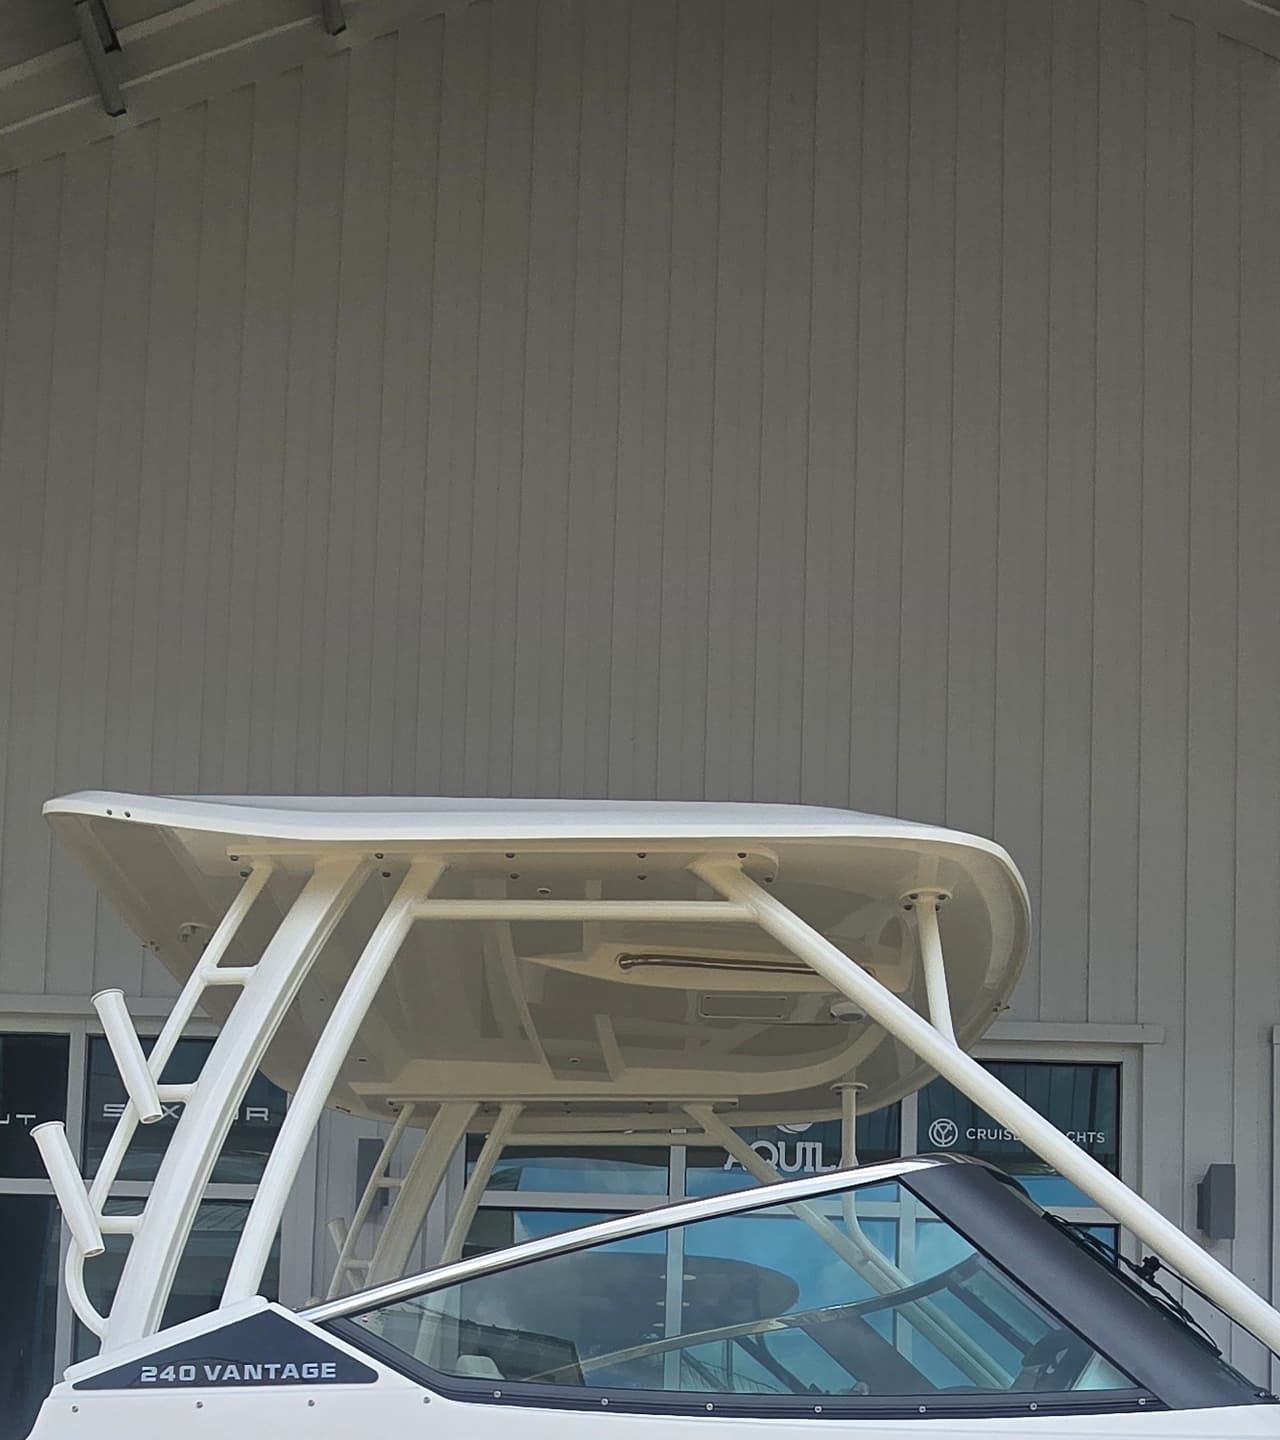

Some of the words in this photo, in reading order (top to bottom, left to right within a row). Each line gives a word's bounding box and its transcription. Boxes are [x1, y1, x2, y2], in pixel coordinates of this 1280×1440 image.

[103, 1103, 269, 1121] SXR
[966, 1127, 1022, 1141] CRUIS
[1065, 1131, 1105, 1144] CHTS
[140, 1365, 196, 1383] 240
[203, 1362, 337, 1382] VANTAGE
